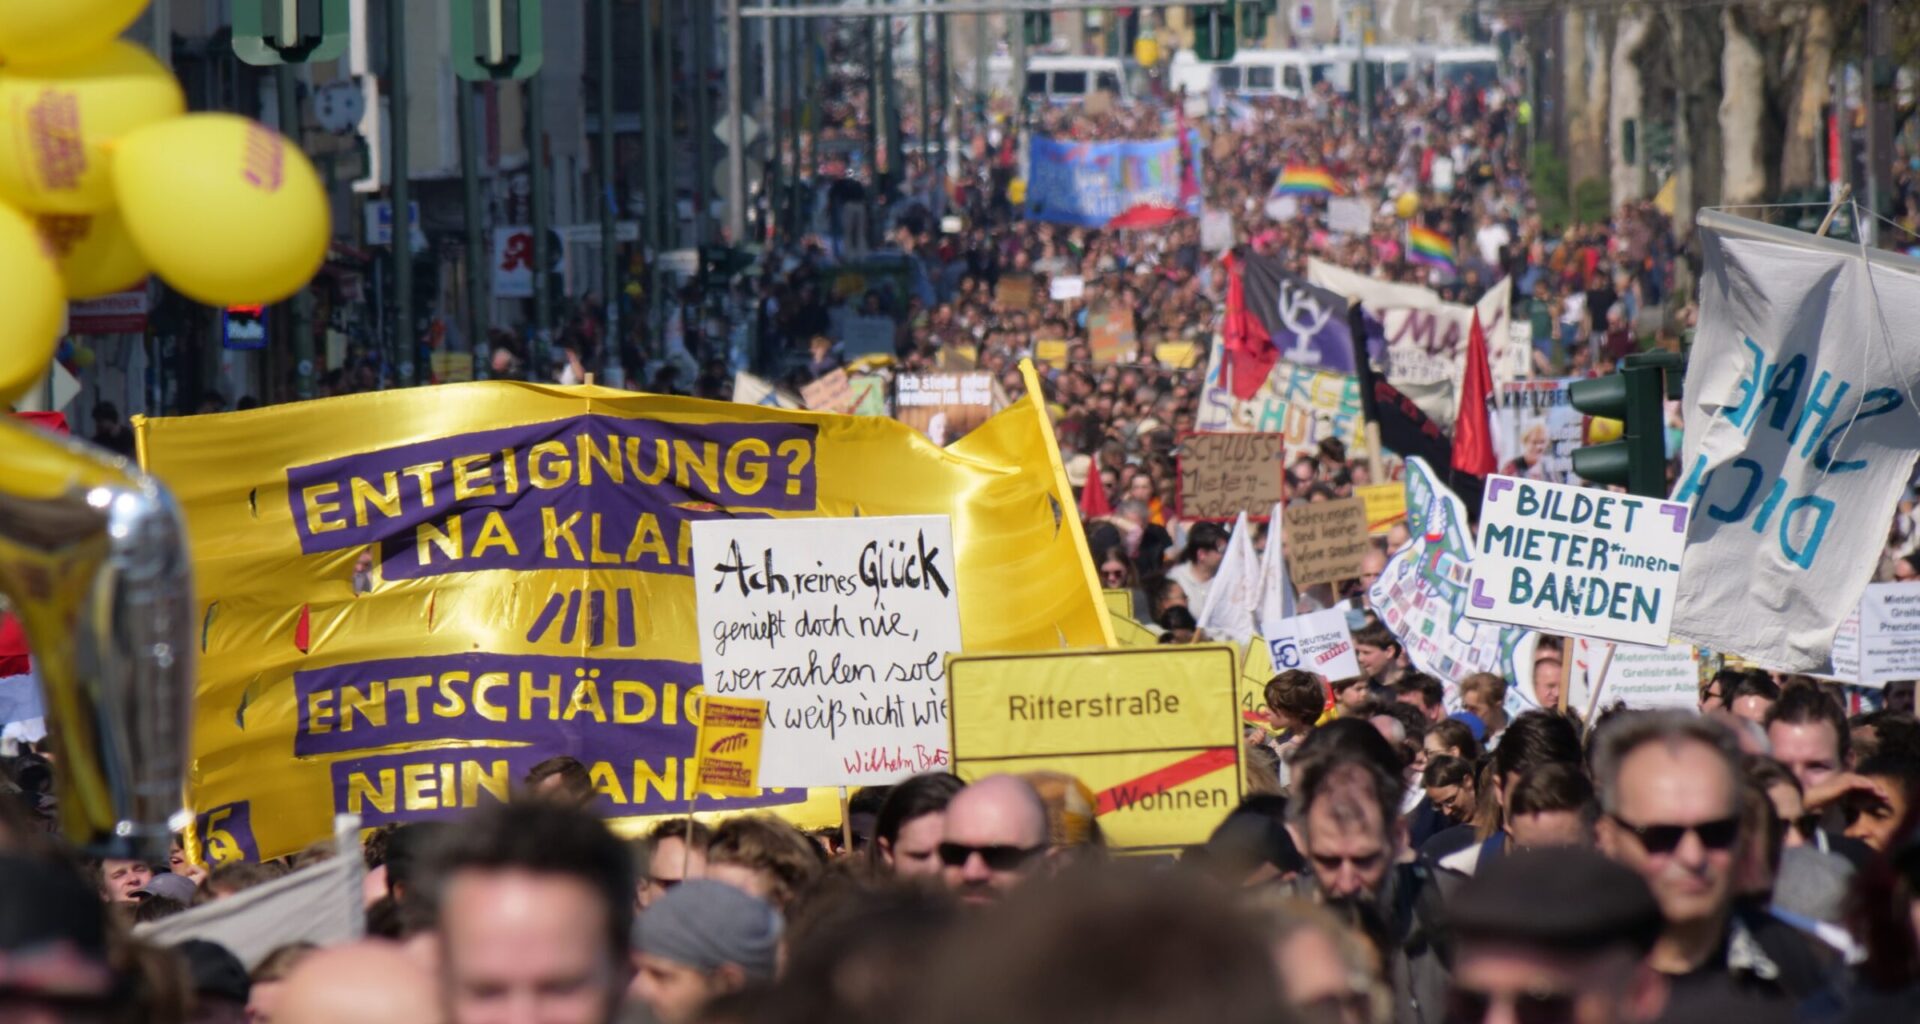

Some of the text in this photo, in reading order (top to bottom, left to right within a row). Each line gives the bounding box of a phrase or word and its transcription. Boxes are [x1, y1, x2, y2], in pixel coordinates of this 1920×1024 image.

[1181, 434, 1278, 463] SCHLUSS
[303, 433, 812, 534] ENTEIGNUNG?
[1516, 483, 1643, 533] BILDET
[416, 511, 519, 566] NA
[858, 528, 951, 606] Glück
[1508, 566, 1661, 625] BANDEN
[713, 602, 919, 656] genießt doch nie,
[1299, 631, 1342, 647] DEUTSCHE
[715, 667, 767, 694] wer
[770, 649, 876, 689] zahlen
[785, 692, 847, 741] weiß
[844, 691, 905, 728] nicht
[1008, 689, 1180, 721] Ritterstraße
[843, 746, 916, 774] Wilhelm
[347, 760, 510, 815] NEIN
[1110, 784, 1229, 812] Wohnen
